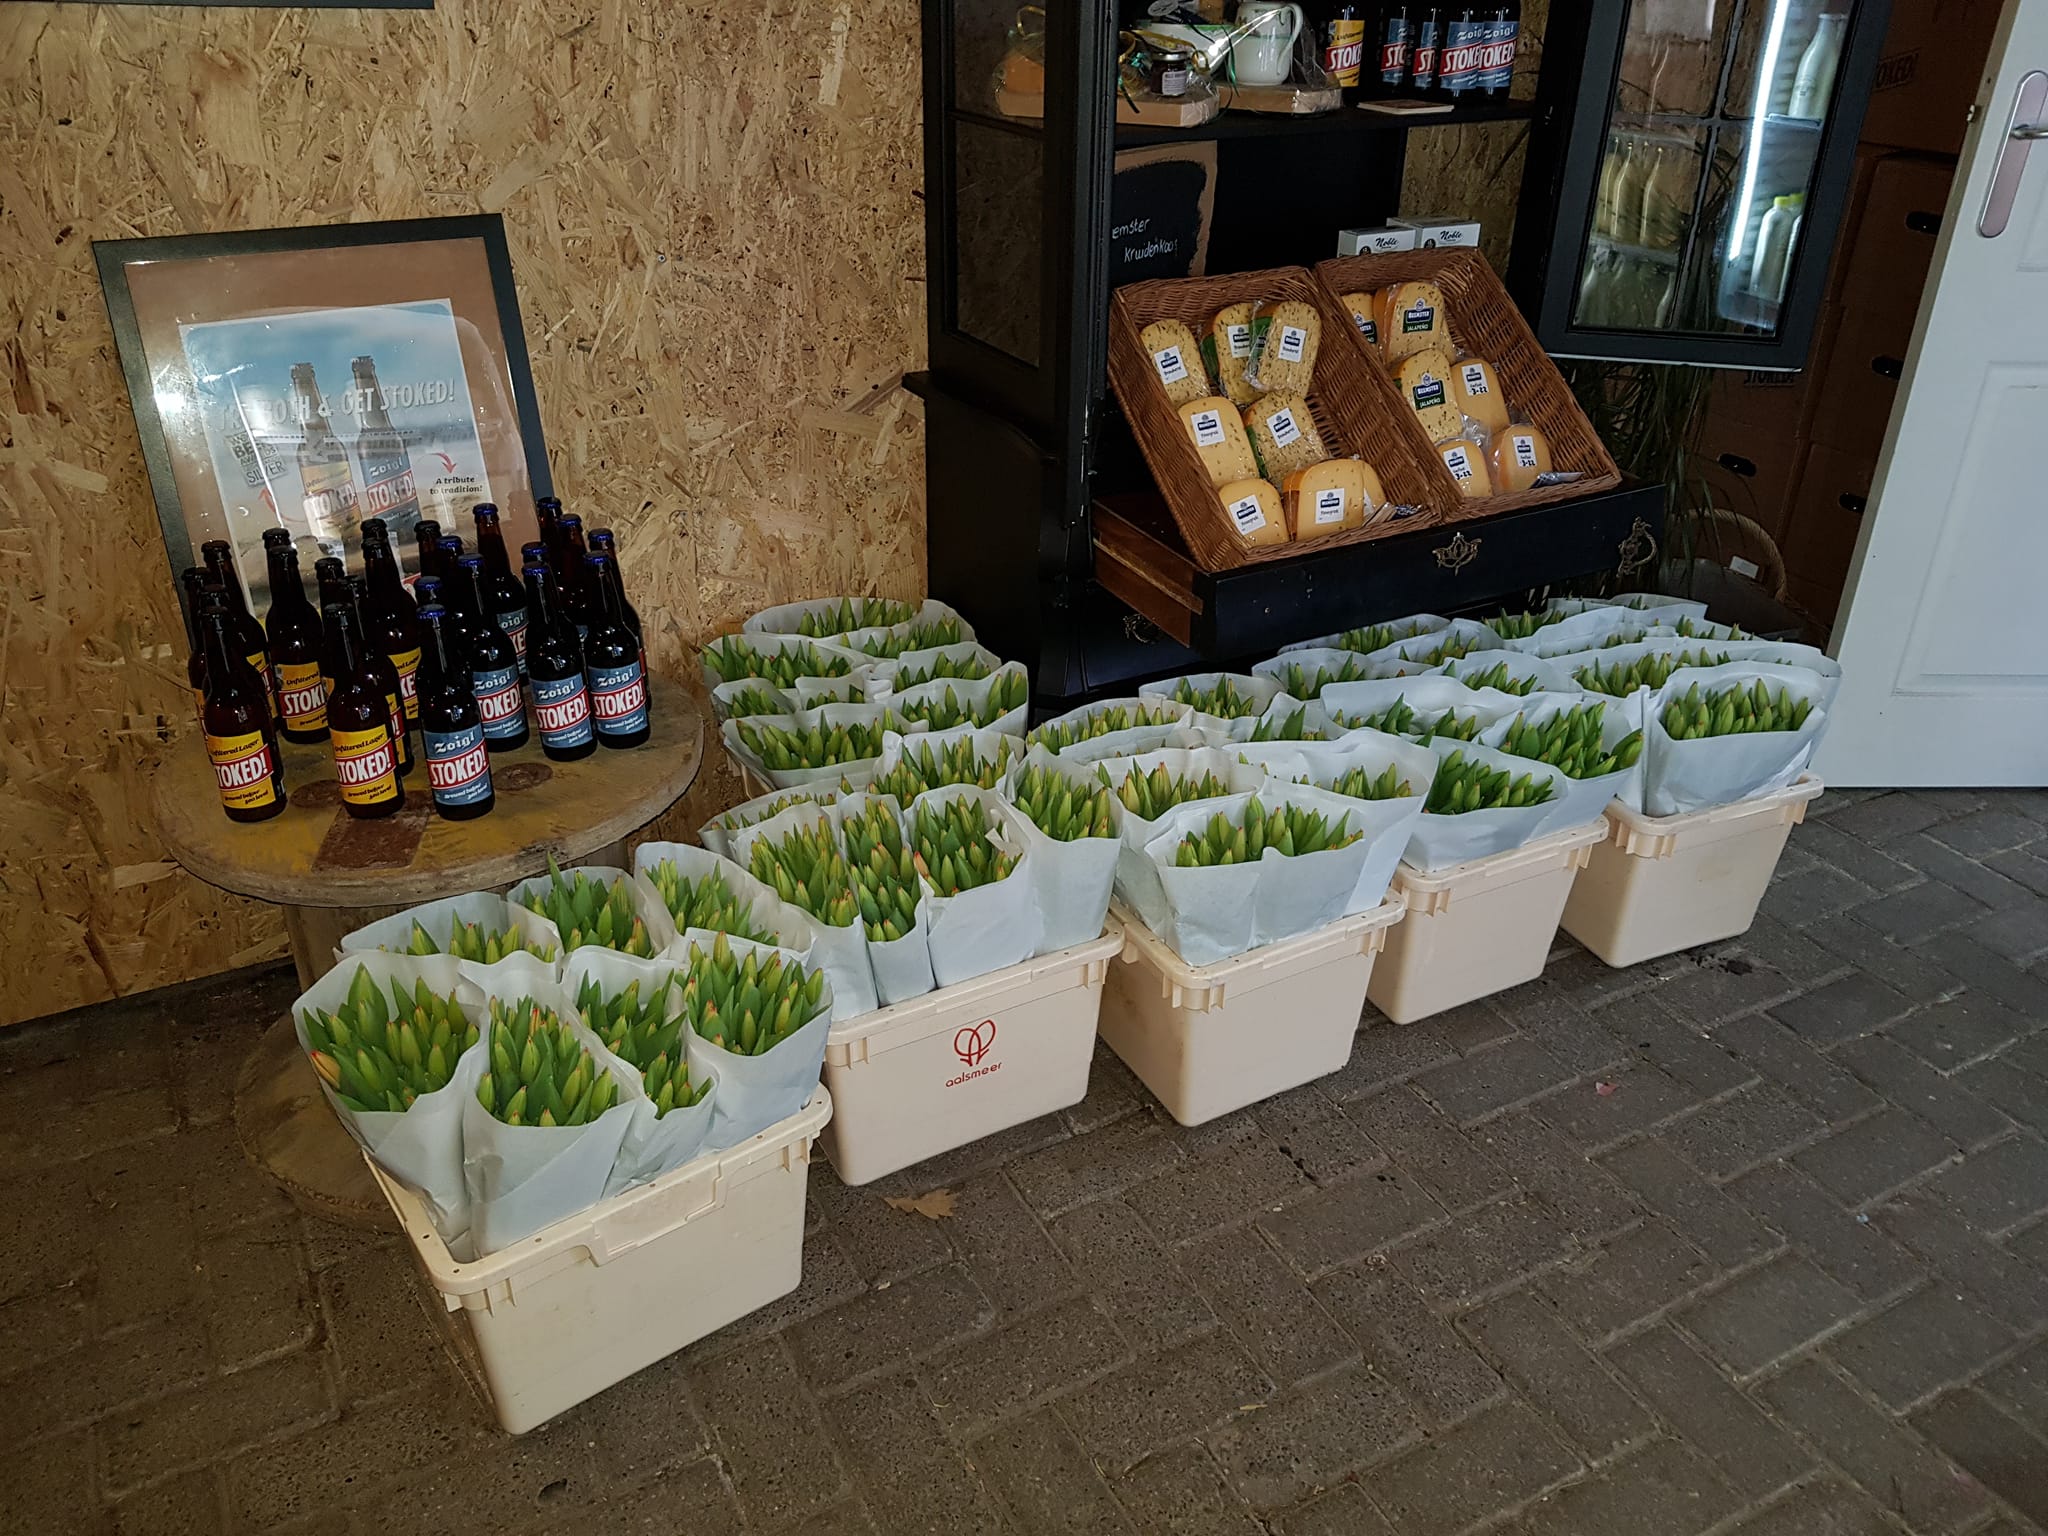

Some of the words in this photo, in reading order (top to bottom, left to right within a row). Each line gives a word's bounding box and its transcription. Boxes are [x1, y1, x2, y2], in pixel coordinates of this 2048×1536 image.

[1375, 237, 1399, 248] Noble
[1440, 230, 1462, 240] Noble
[341, 387, 374, 415] GET
[379, 380, 456, 411] STOKED!
[436, 478, 444, 486] A
[447, 476, 475, 486] tribute
[367, 472, 416, 512] STOKED!
[474, 671, 511, 690] Zoigl
[597, 667, 633, 687] Zoigl
[538, 679, 575, 700] Zoigl
[594, 680, 643, 716] STOKED!
[536, 693, 587, 729] STOKED!
[239, 738, 259, 751] Lager
[365, 733, 384, 745] Lager
[434, 730, 475, 754] Zoigl
[430, 745, 487, 786] STOKED!
[945, 1062, 1002, 1088] aalsmeer
